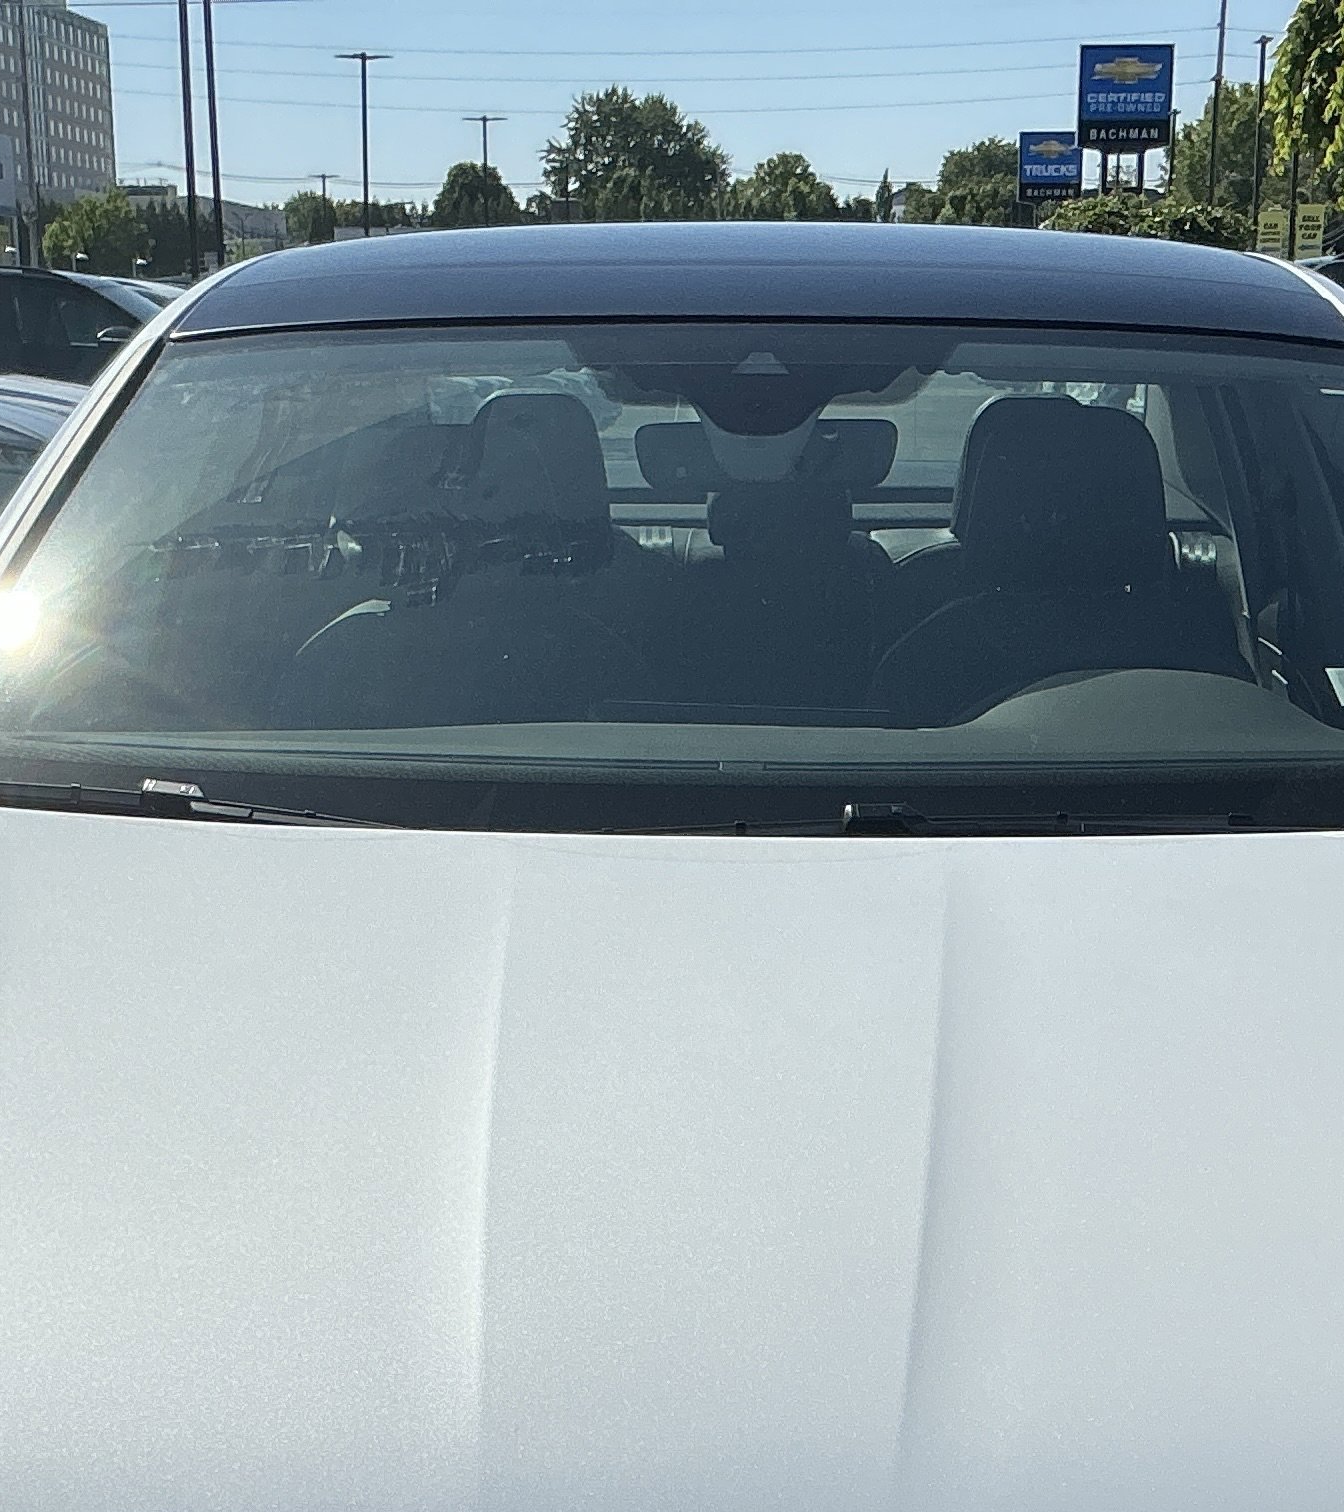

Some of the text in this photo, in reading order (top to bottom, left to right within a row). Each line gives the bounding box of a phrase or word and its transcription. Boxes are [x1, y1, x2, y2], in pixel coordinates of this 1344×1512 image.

[1086, 92, 1166, 103] CERTIFIED
[1089, 102, 1161, 113] PRE-OWNED
[1088, 127, 1159, 140] BACHMAN
[1023, 164, 1078, 177] TRUCKS
